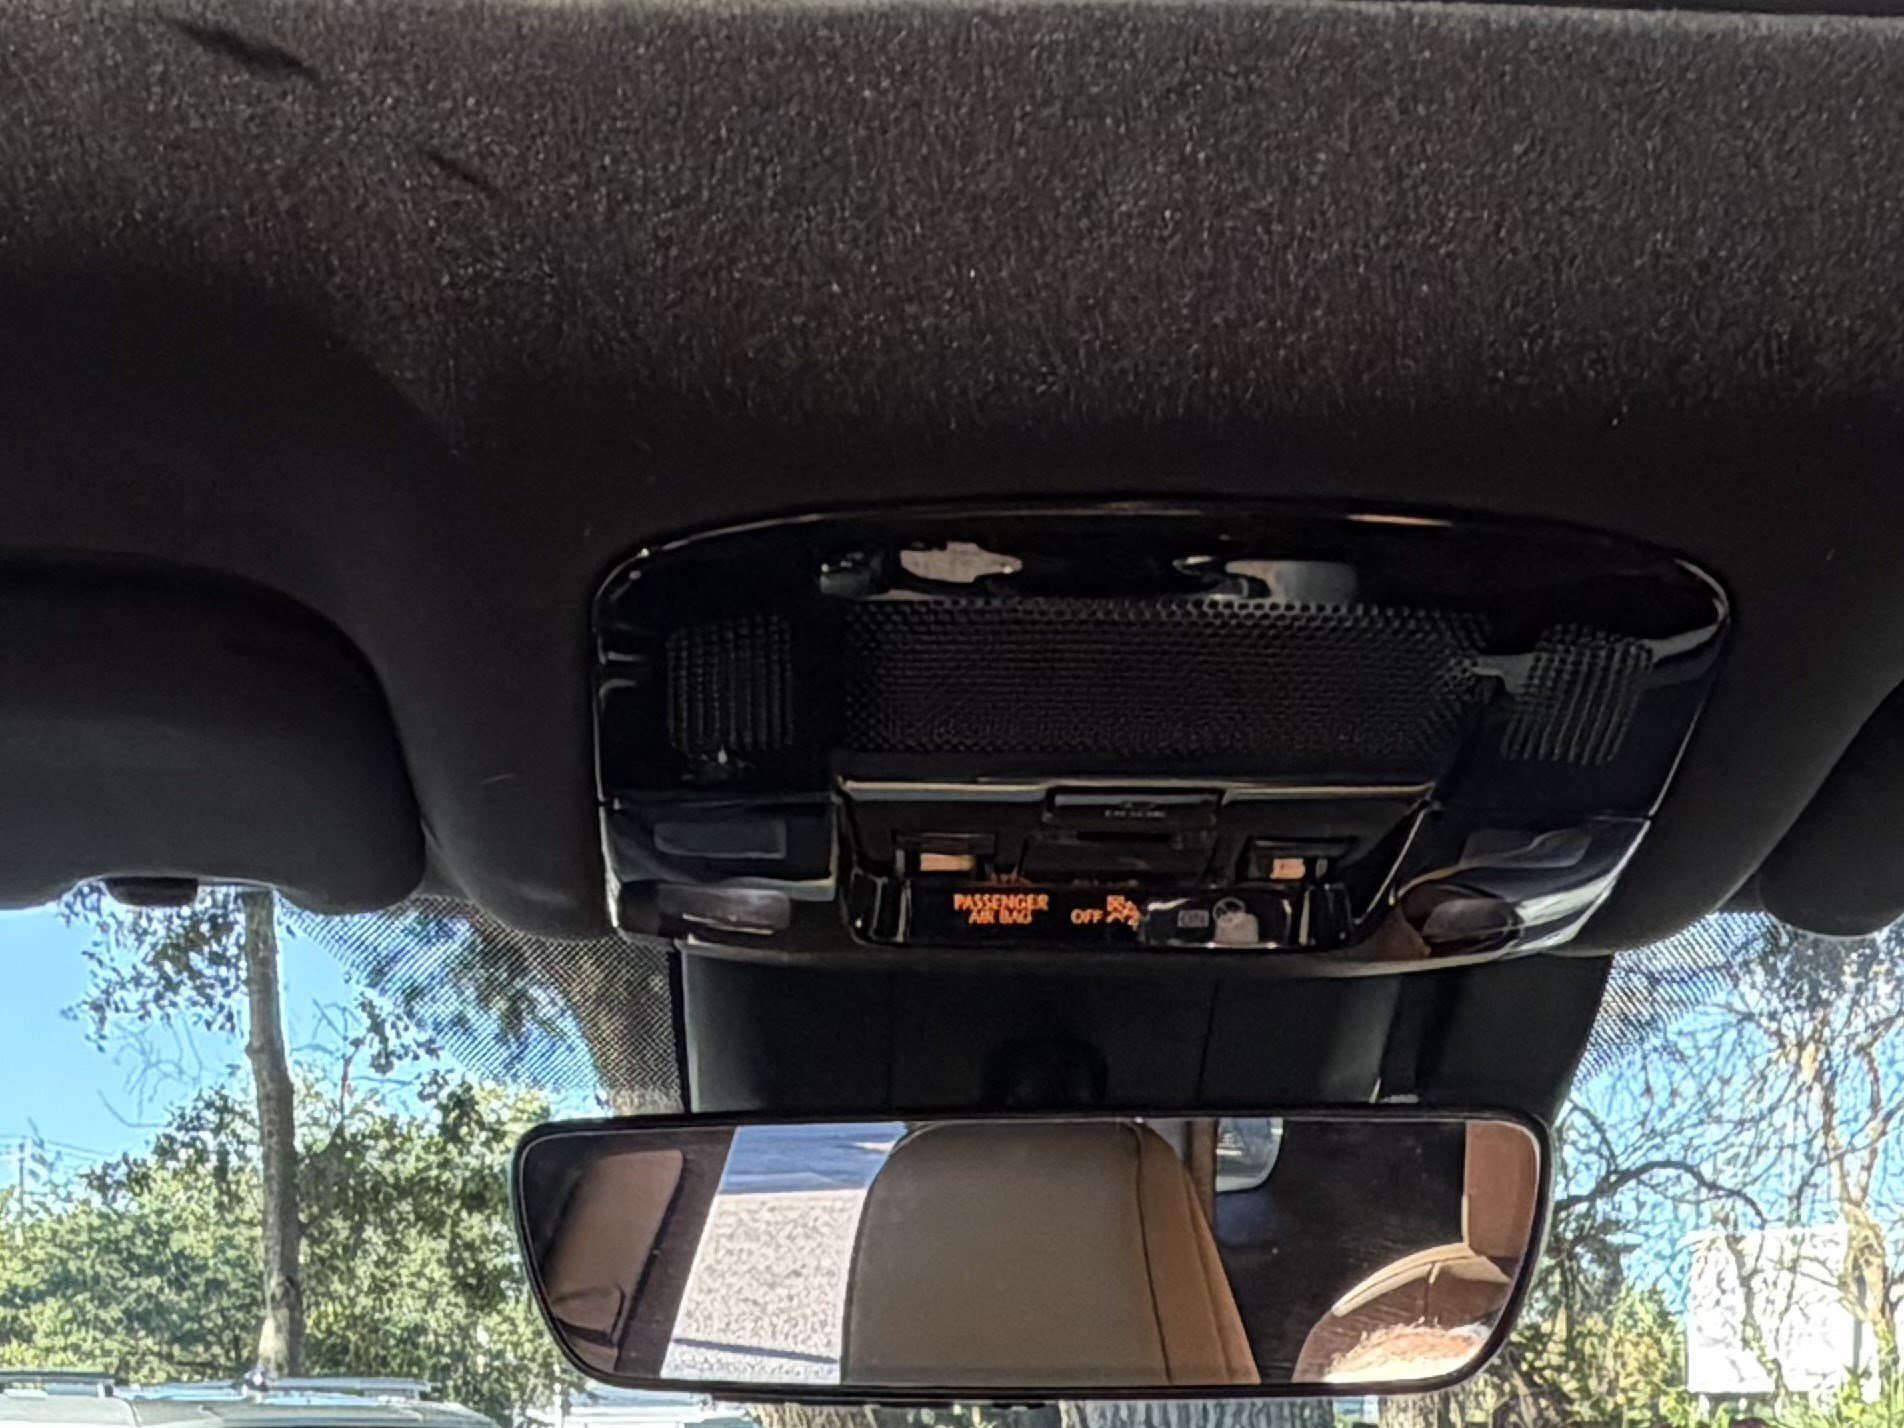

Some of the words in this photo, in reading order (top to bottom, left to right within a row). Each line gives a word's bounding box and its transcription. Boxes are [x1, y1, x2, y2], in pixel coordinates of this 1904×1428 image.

[953, 893, 1049, 911] PASSENGER
[968, 909, 994, 924] AIR
[999, 909, 1033, 925] BAG
[1071, 909, 1103, 925] OFF
